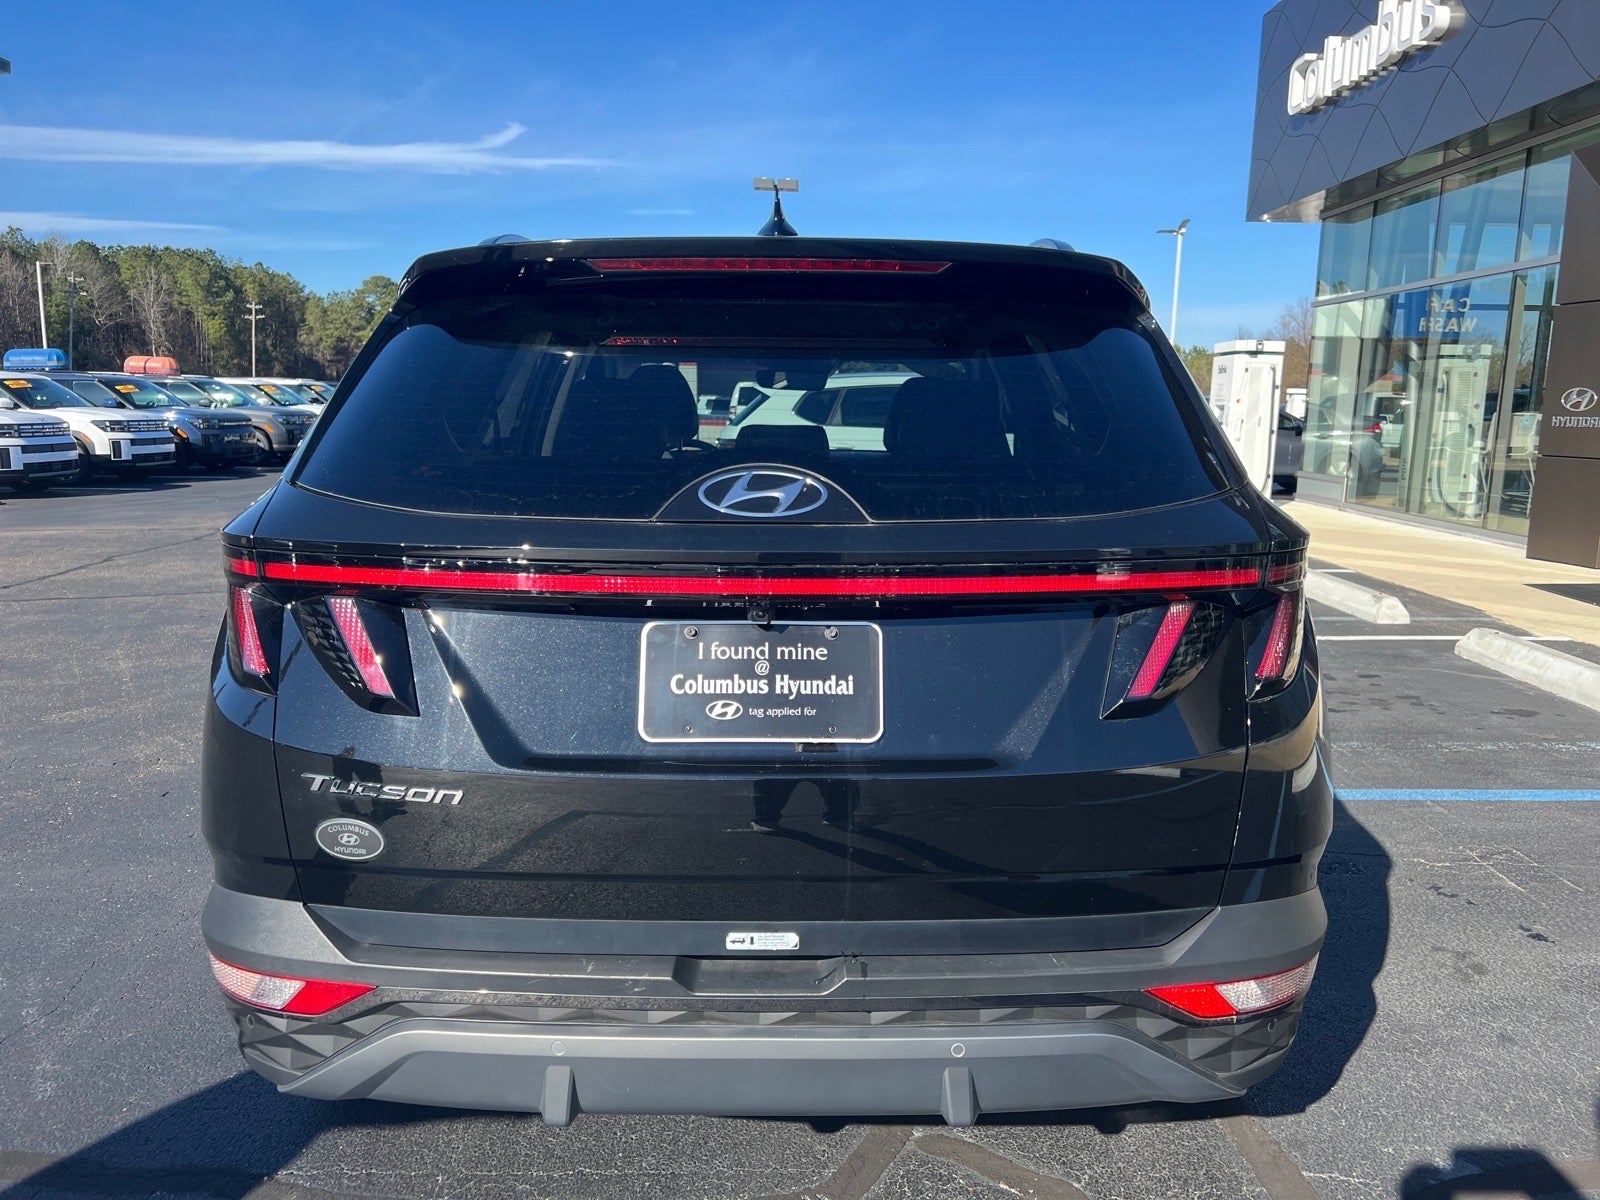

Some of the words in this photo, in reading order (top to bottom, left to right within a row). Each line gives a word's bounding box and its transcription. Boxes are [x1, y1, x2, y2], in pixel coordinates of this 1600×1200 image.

[1288, 0, 1450, 115] Columbus
[710, 642, 769, 660] found
[777, 643, 828, 661] mine
[755, 660, 770, 675] @
[670, 674, 769, 694] Columbus
[775, 674, 854, 699] Hyundai
[749, 707, 764, 718] tag
[766, 706, 801, 717] applied
[803, 706, 817, 716] for
[328, 824, 369, 836] COLUMBUS
[334, 845, 367, 855] HYUNDAI
